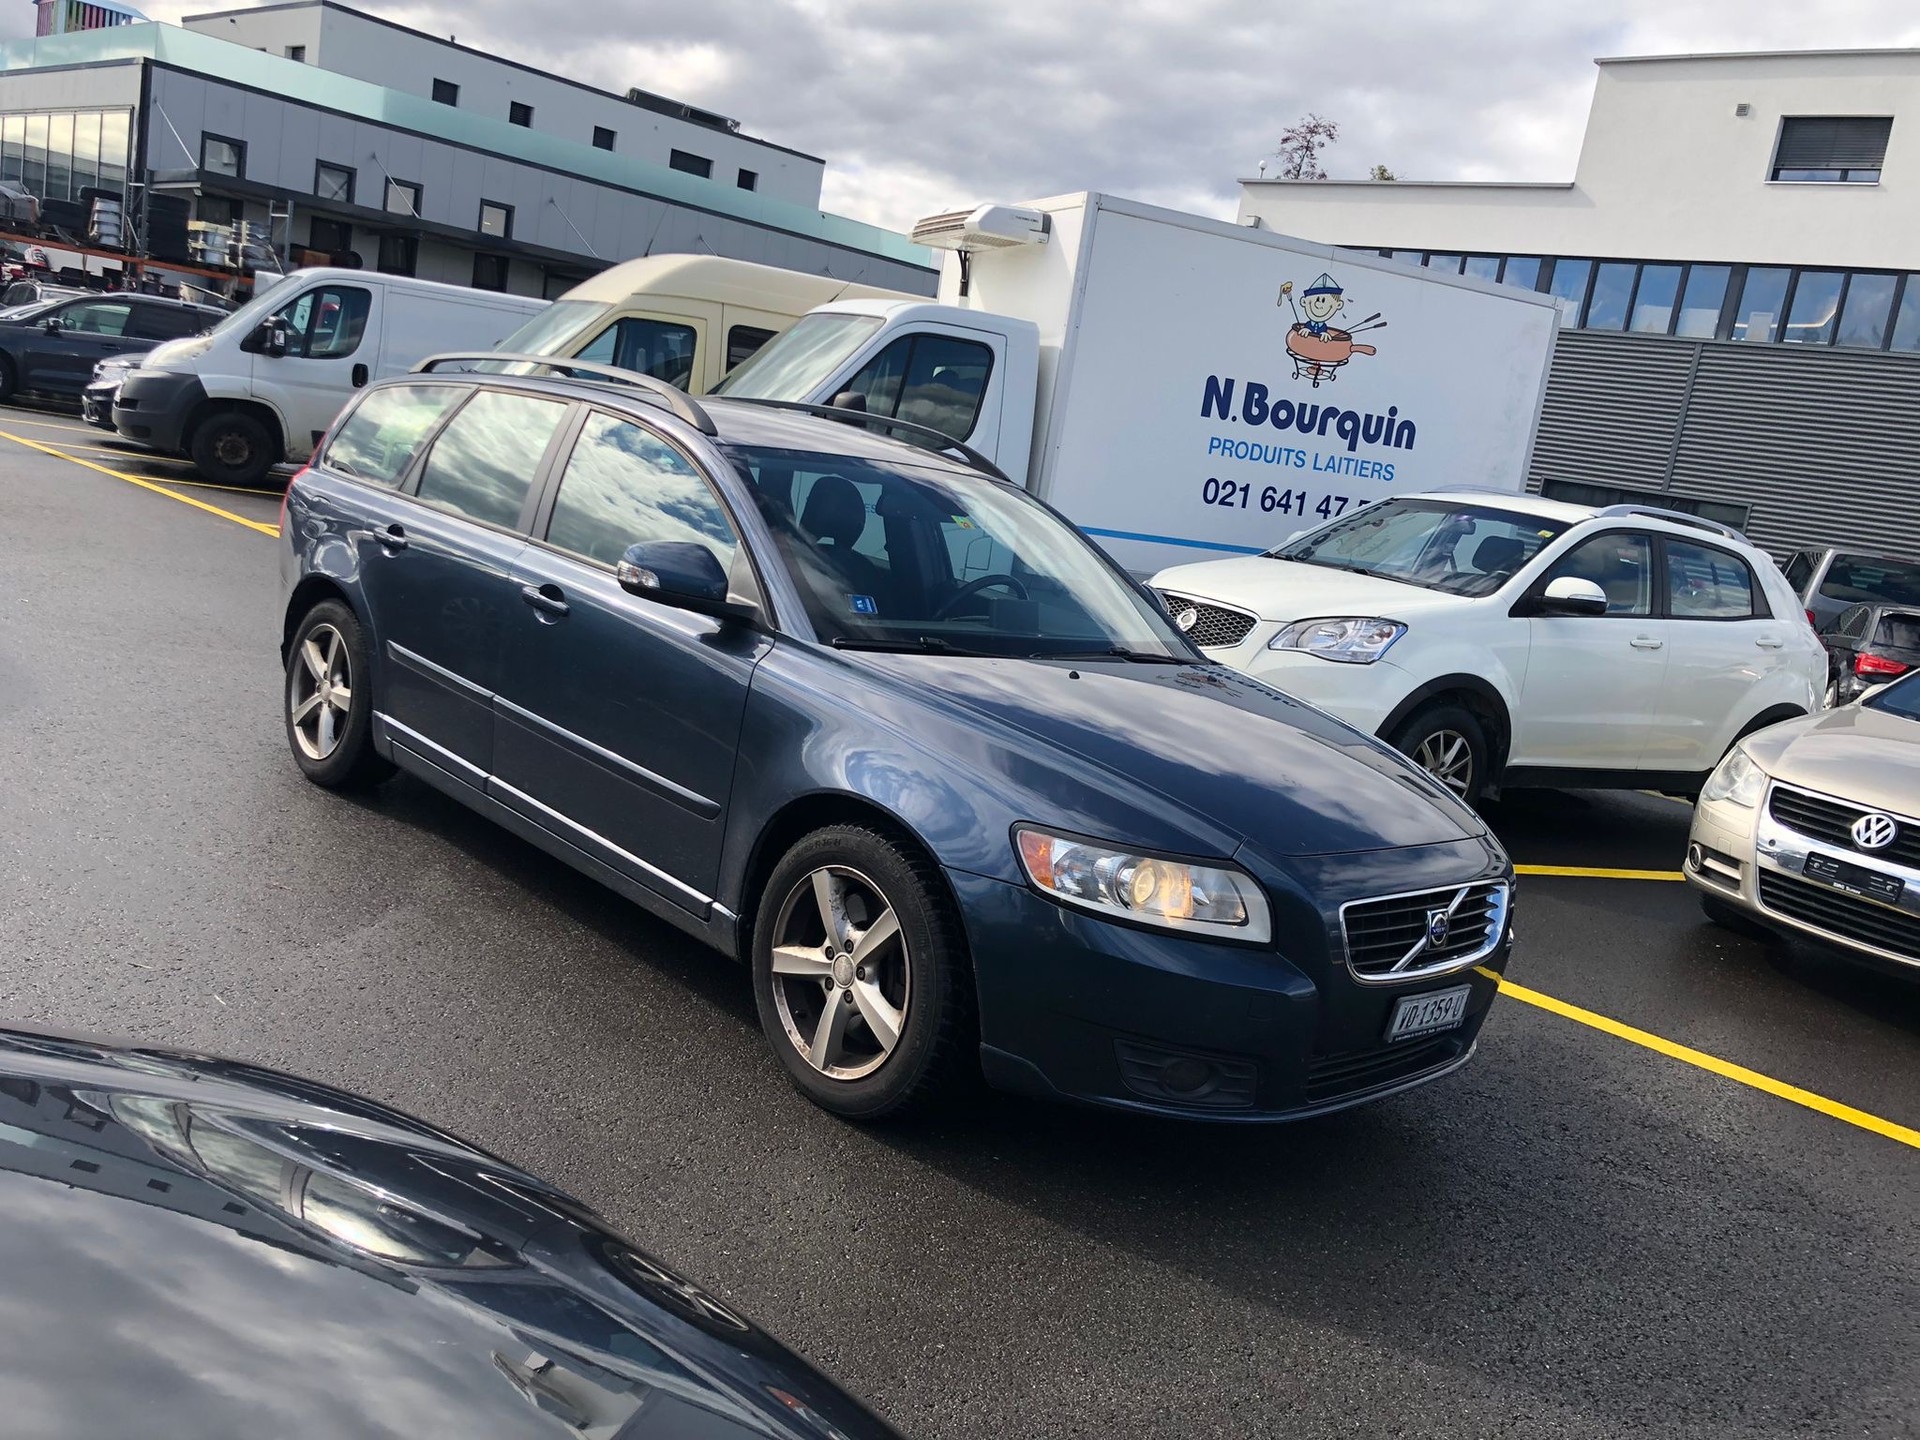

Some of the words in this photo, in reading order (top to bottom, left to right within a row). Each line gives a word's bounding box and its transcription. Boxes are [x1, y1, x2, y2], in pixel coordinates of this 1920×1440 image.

[1208, 437, 1306, 468] PRODUITS
[1313, 453, 1395, 481] LAITIERS
[1203, 478, 1250, 509] 021
[1260, 486, 1306, 517] 641
[1315, 494, 1348, 519] 47
